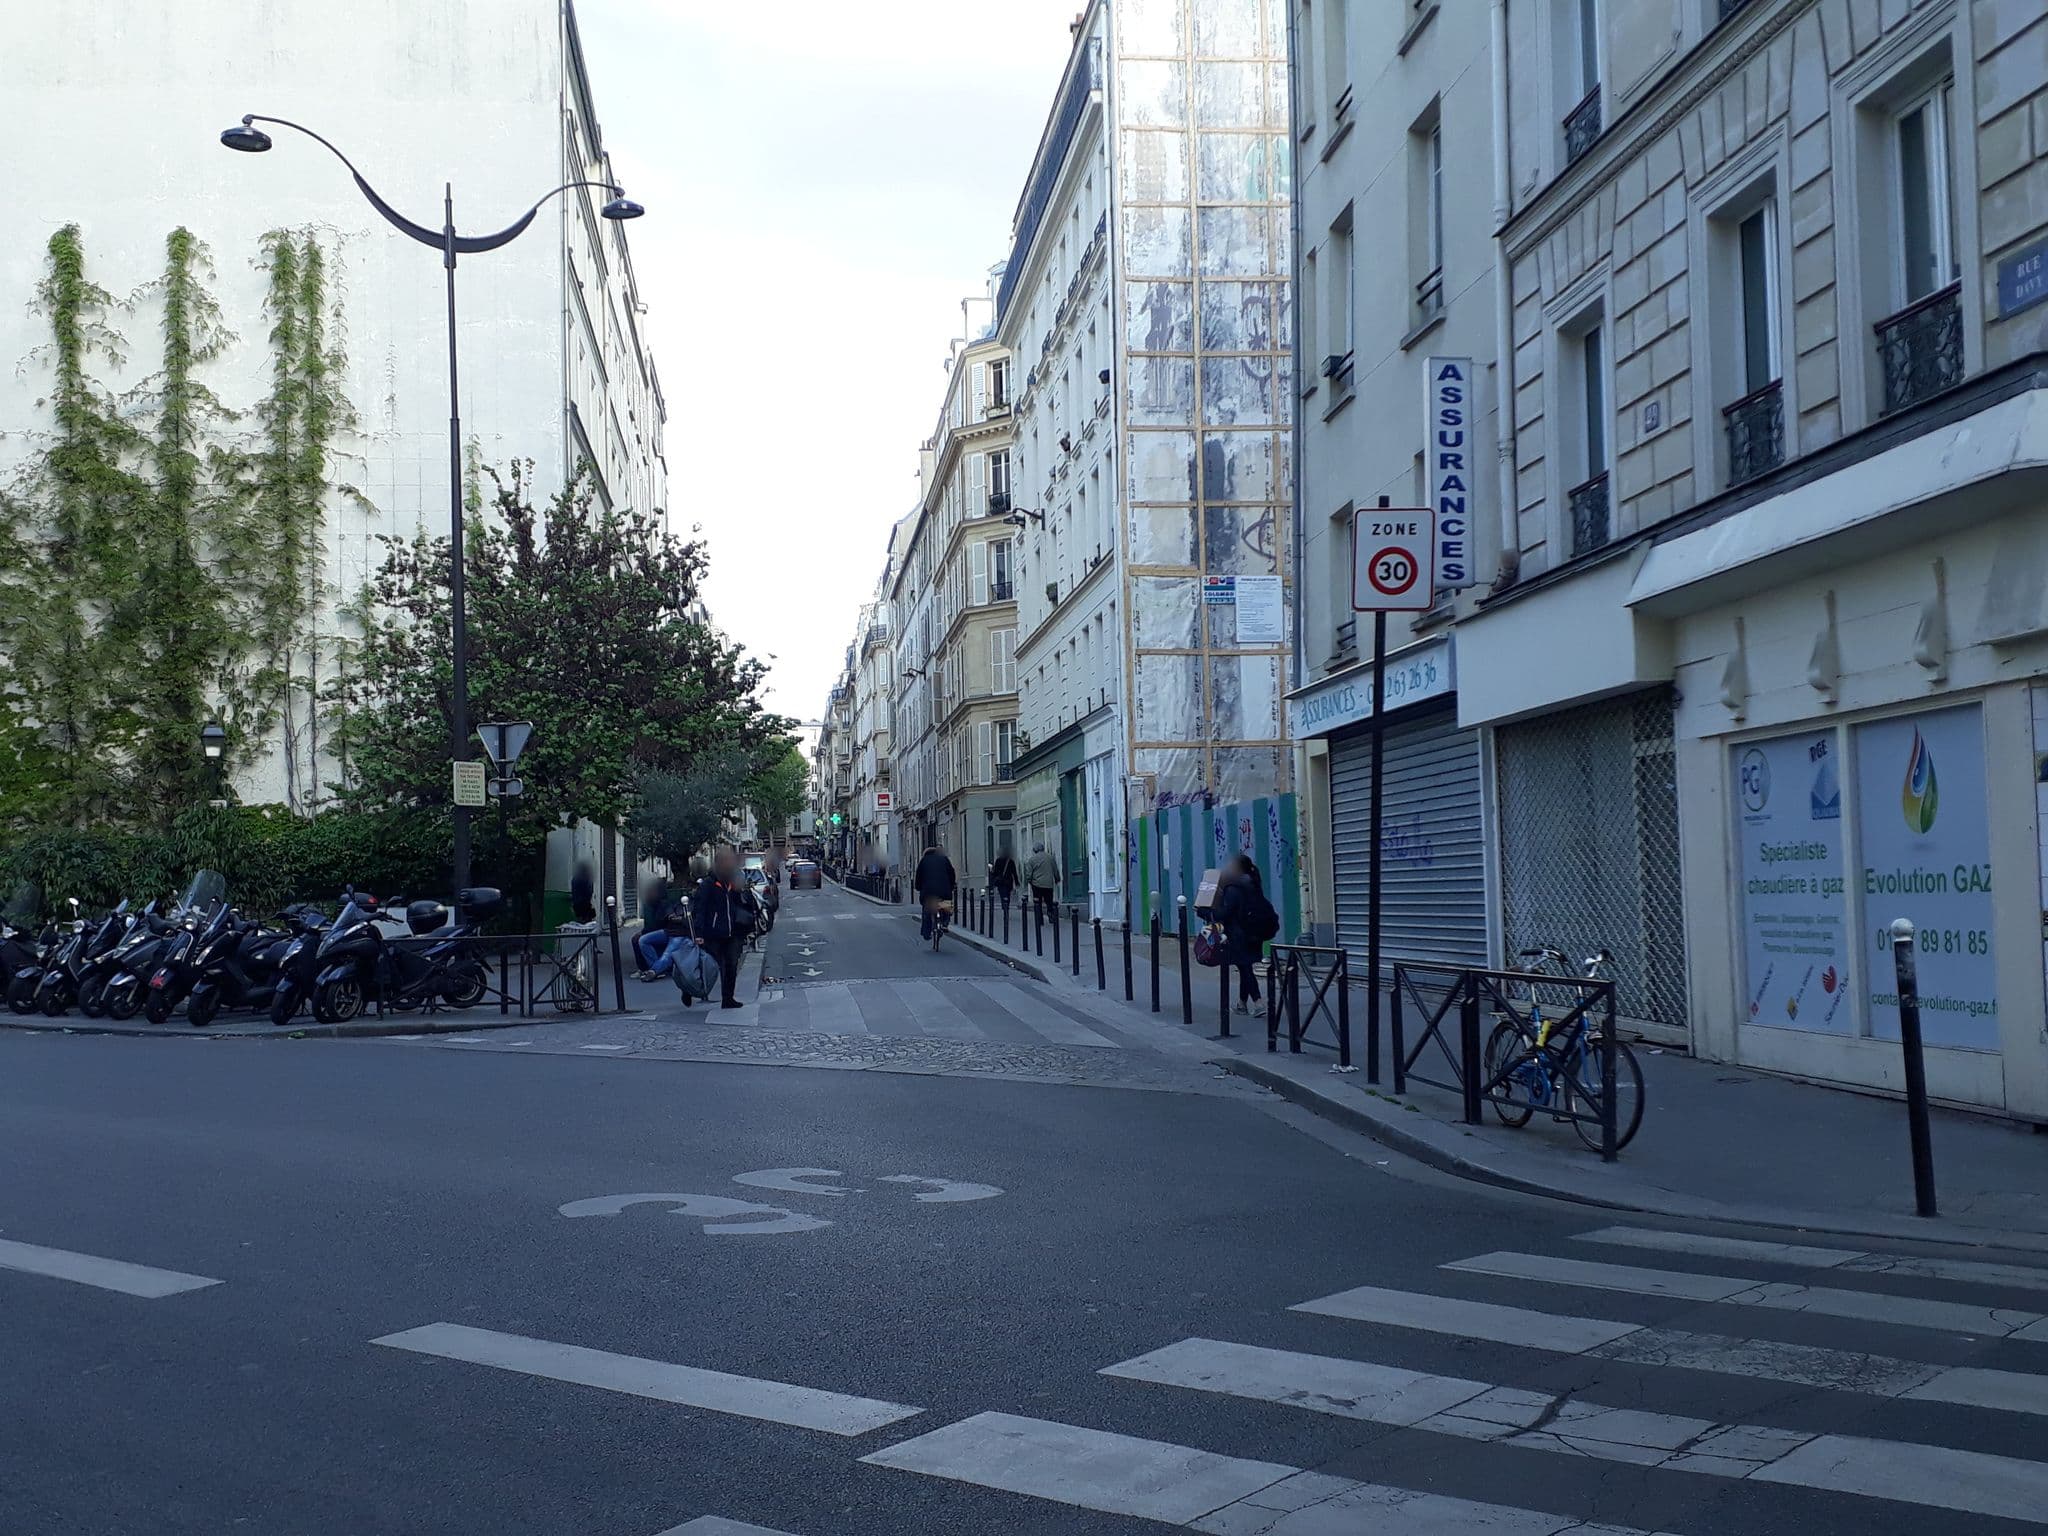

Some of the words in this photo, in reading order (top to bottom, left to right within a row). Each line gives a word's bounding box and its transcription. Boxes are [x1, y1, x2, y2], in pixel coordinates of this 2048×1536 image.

[2017, 254, 2041, 278] RUE
[1437, 364, 1466, 581] ASSURANCES
[1371, 523, 1417, 536] ZONE
[1378, 561, 1408, 581] 30
[1302, 682, 1355, 732] ASSURANCES
[1394, 670, 1406, 697] 63
[1408, 661, 1421, 690] 26
[1424, 656, 1437, 689] 36
[1761, 840, 1827, 867] Spécialiste
[1749, 872, 1807, 894] chaudière
[1810, 872, 1818, 894] à
[1822, 877, 1844, 899] gaz
[1865, 867, 1948, 894] Evolution
[1954, 864, 1992, 893] GAZ
[1921, 929, 1939, 953] 89
[1944, 930, 1961, 954] 81
[1968, 930, 1988, 955] 85
